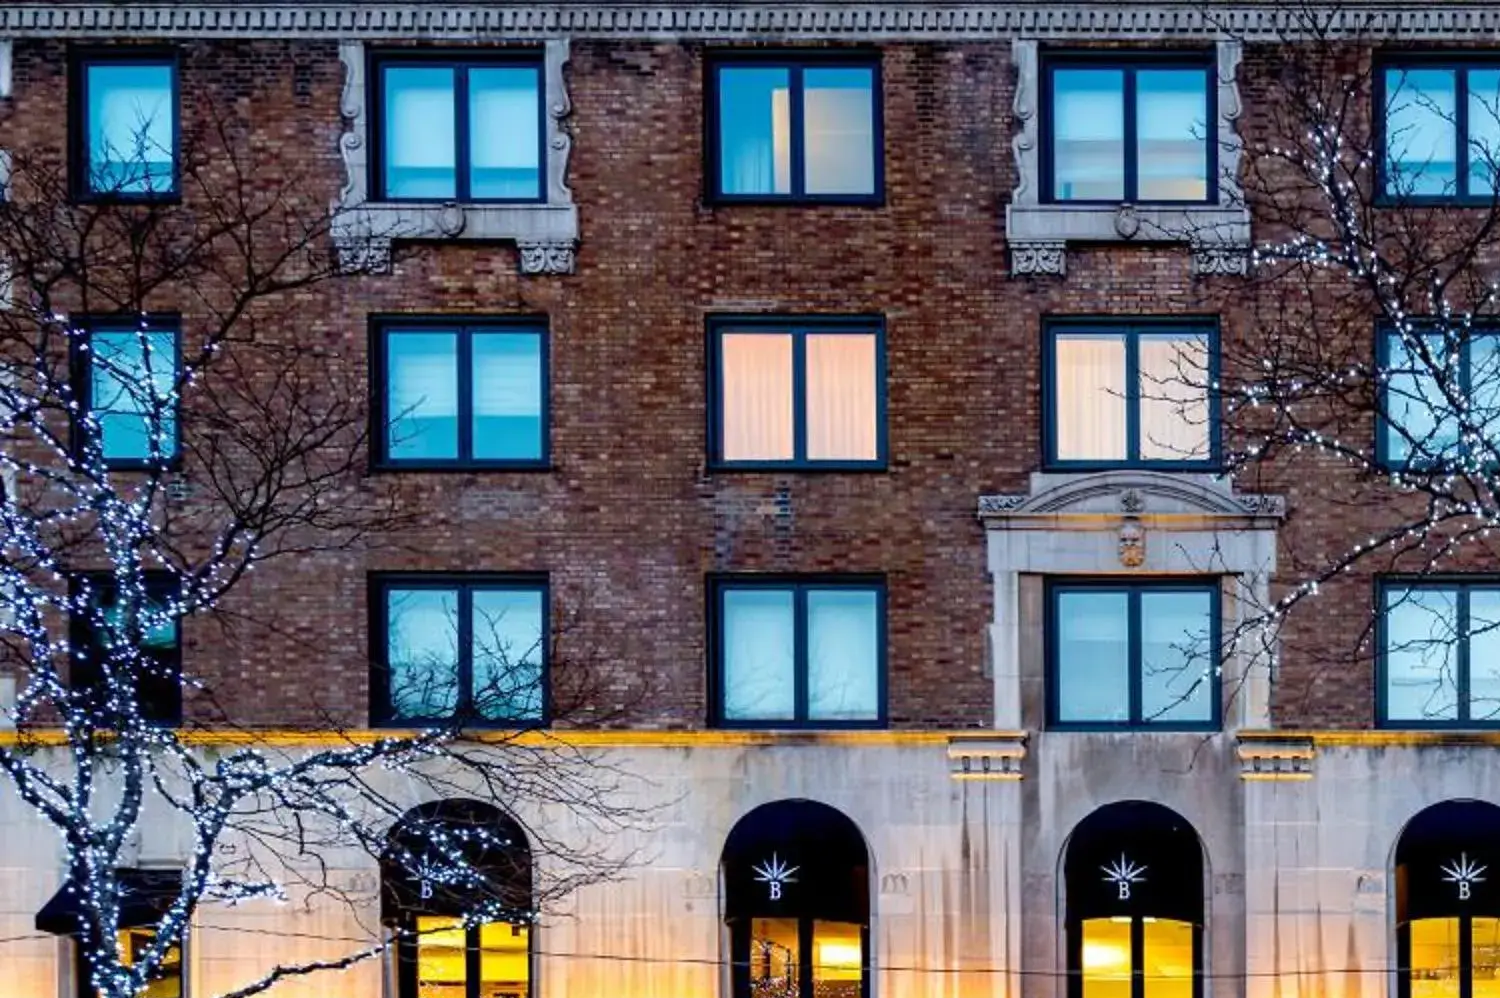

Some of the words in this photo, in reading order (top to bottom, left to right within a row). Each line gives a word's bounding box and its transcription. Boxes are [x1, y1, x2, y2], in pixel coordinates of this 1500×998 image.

[420, 880, 433, 899] B
[770, 881, 782, 899] B
[1118, 882, 1131, 899] B
[1458, 882, 1471, 899] B
